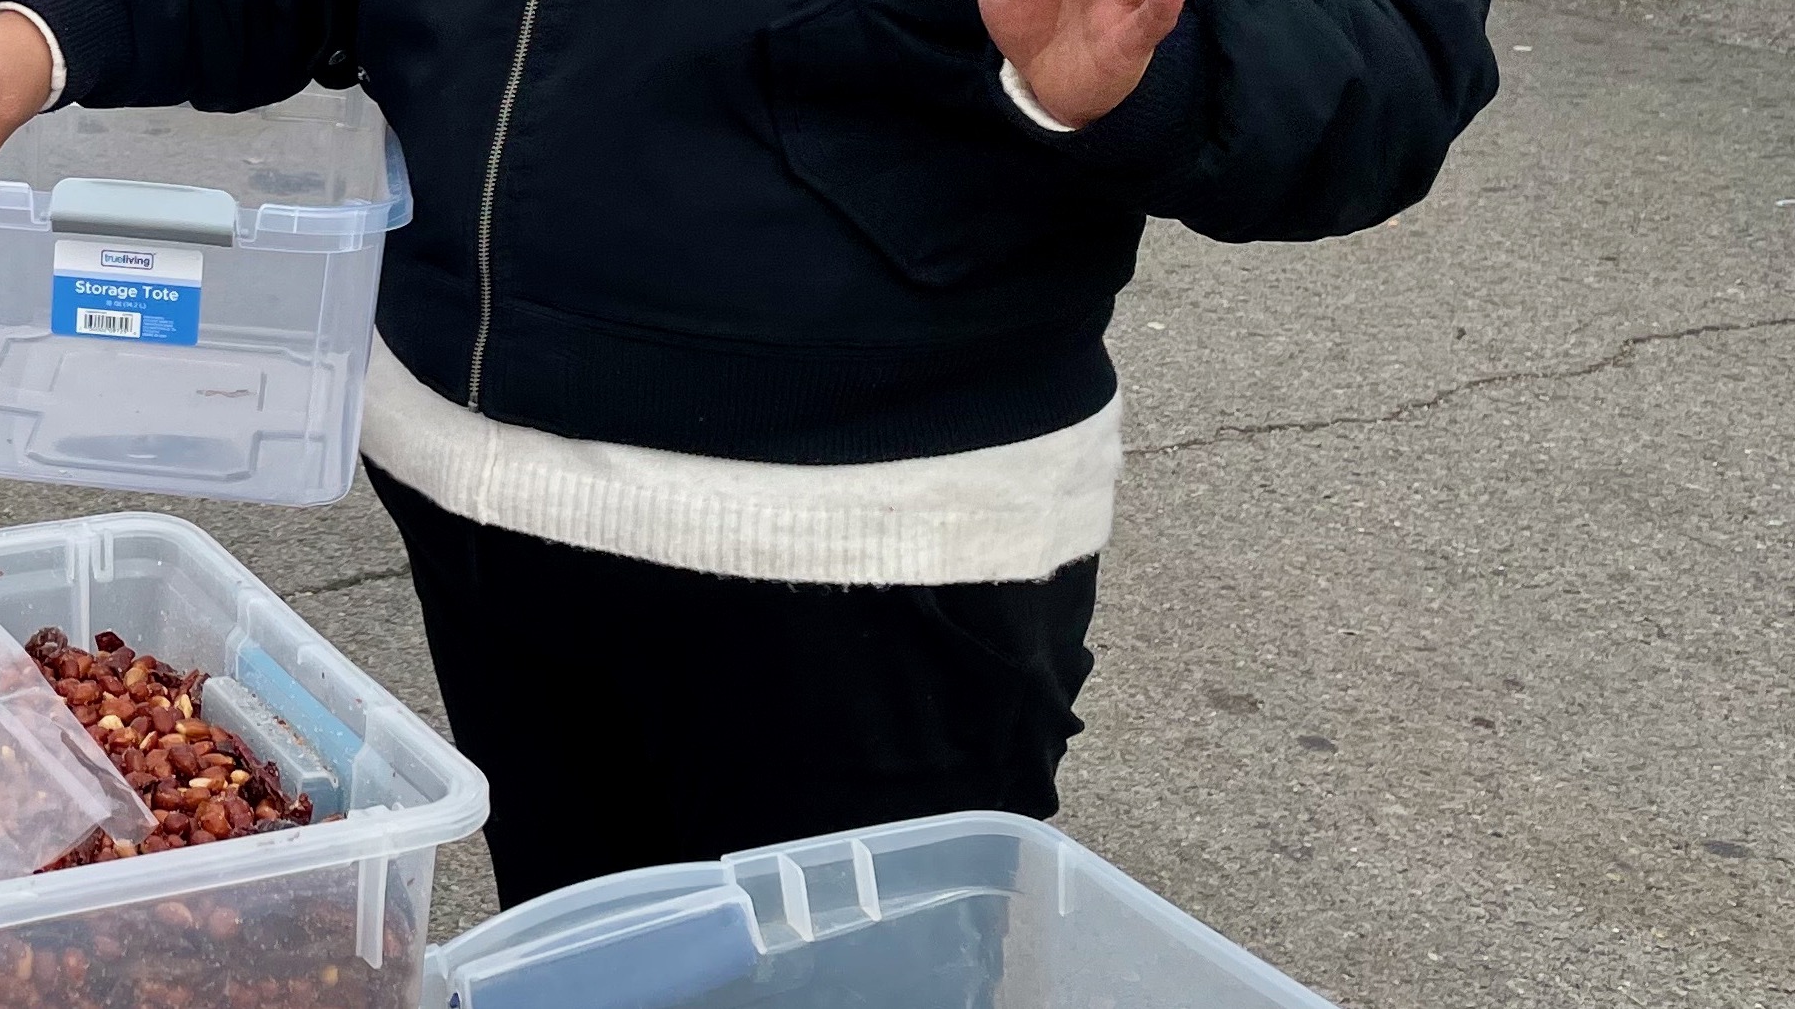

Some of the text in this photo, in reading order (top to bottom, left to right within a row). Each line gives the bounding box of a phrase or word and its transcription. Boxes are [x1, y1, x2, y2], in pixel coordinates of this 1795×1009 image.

[105, 254, 150, 268] trueliving
[75, 280, 179, 302] Storage Tote
